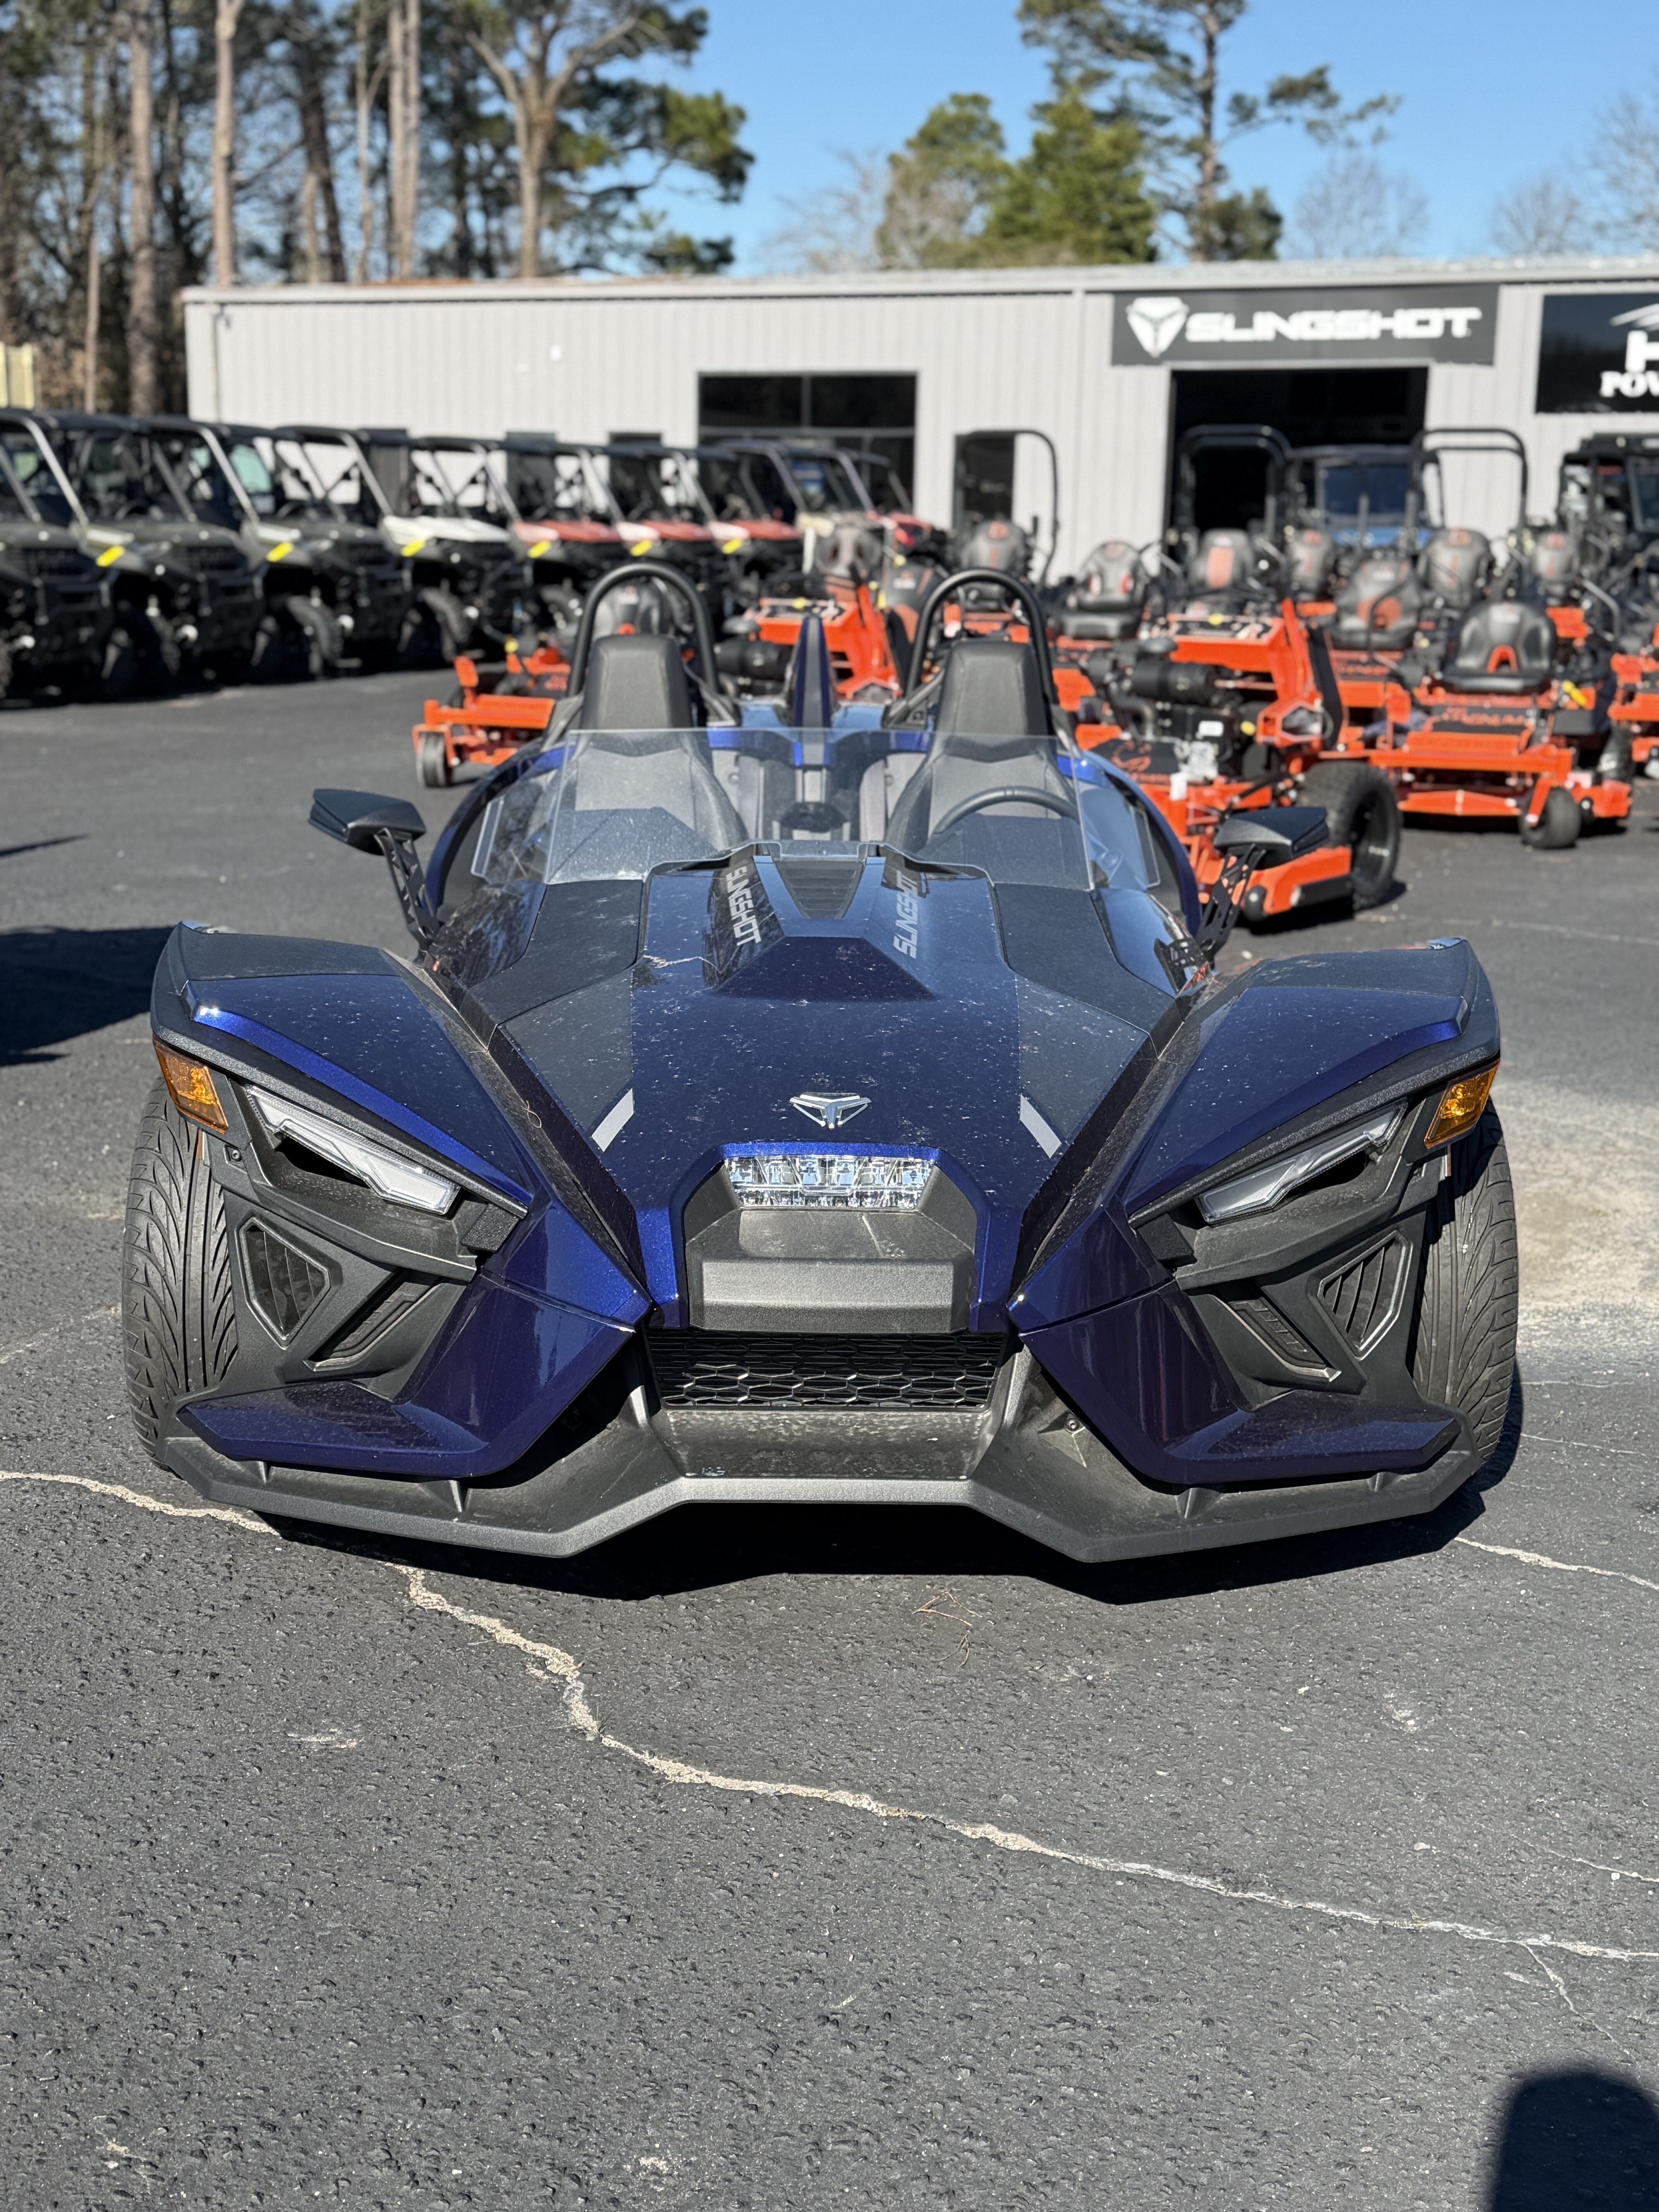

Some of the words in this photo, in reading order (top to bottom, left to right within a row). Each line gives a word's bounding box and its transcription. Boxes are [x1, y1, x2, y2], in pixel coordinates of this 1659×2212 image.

[1185, 307, 1482, 342] SLINGSHOT
[726, 866, 761, 946] SLINGSHOT
[893, 870, 918, 959] SLINGSHOT
